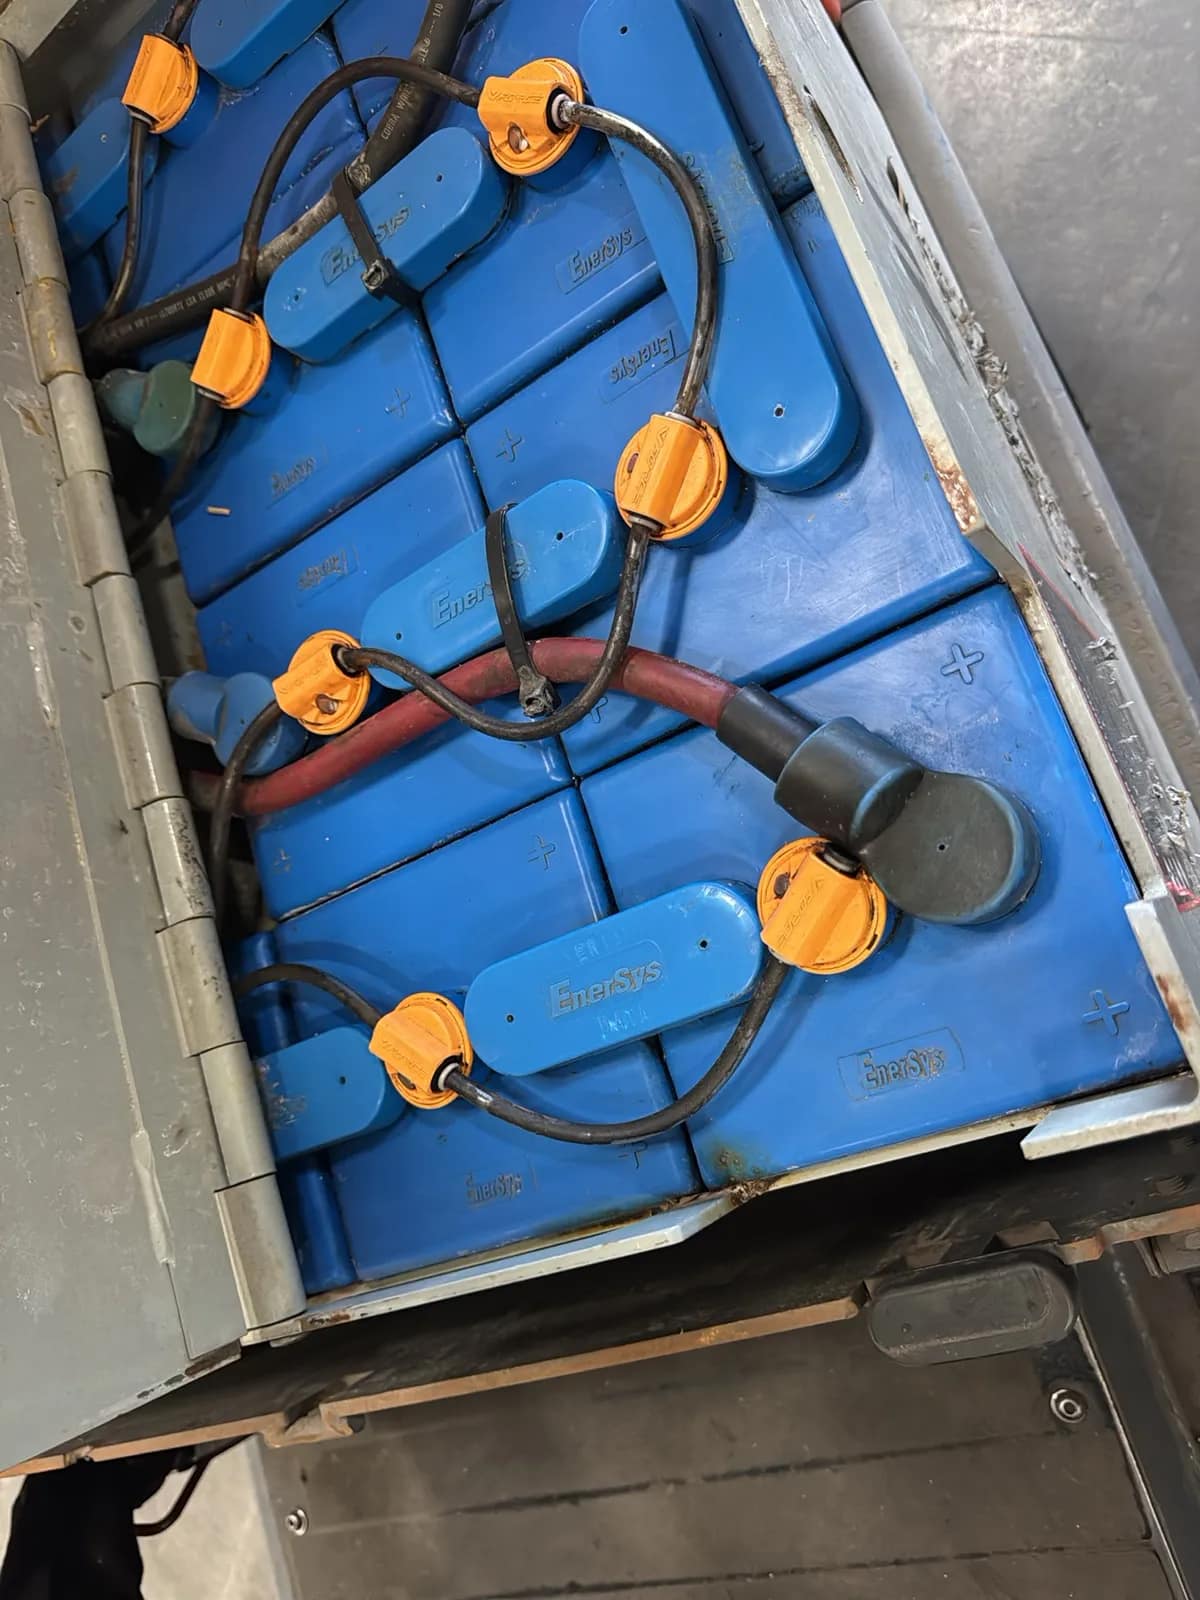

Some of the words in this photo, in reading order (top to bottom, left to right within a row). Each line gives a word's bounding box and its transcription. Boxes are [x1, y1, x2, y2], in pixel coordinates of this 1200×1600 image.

[567, 228, 633, 283] EnerSys
[550, 960, 663, 1018] EnerSys
[857, 1048, 945, 1090] EnerSys
